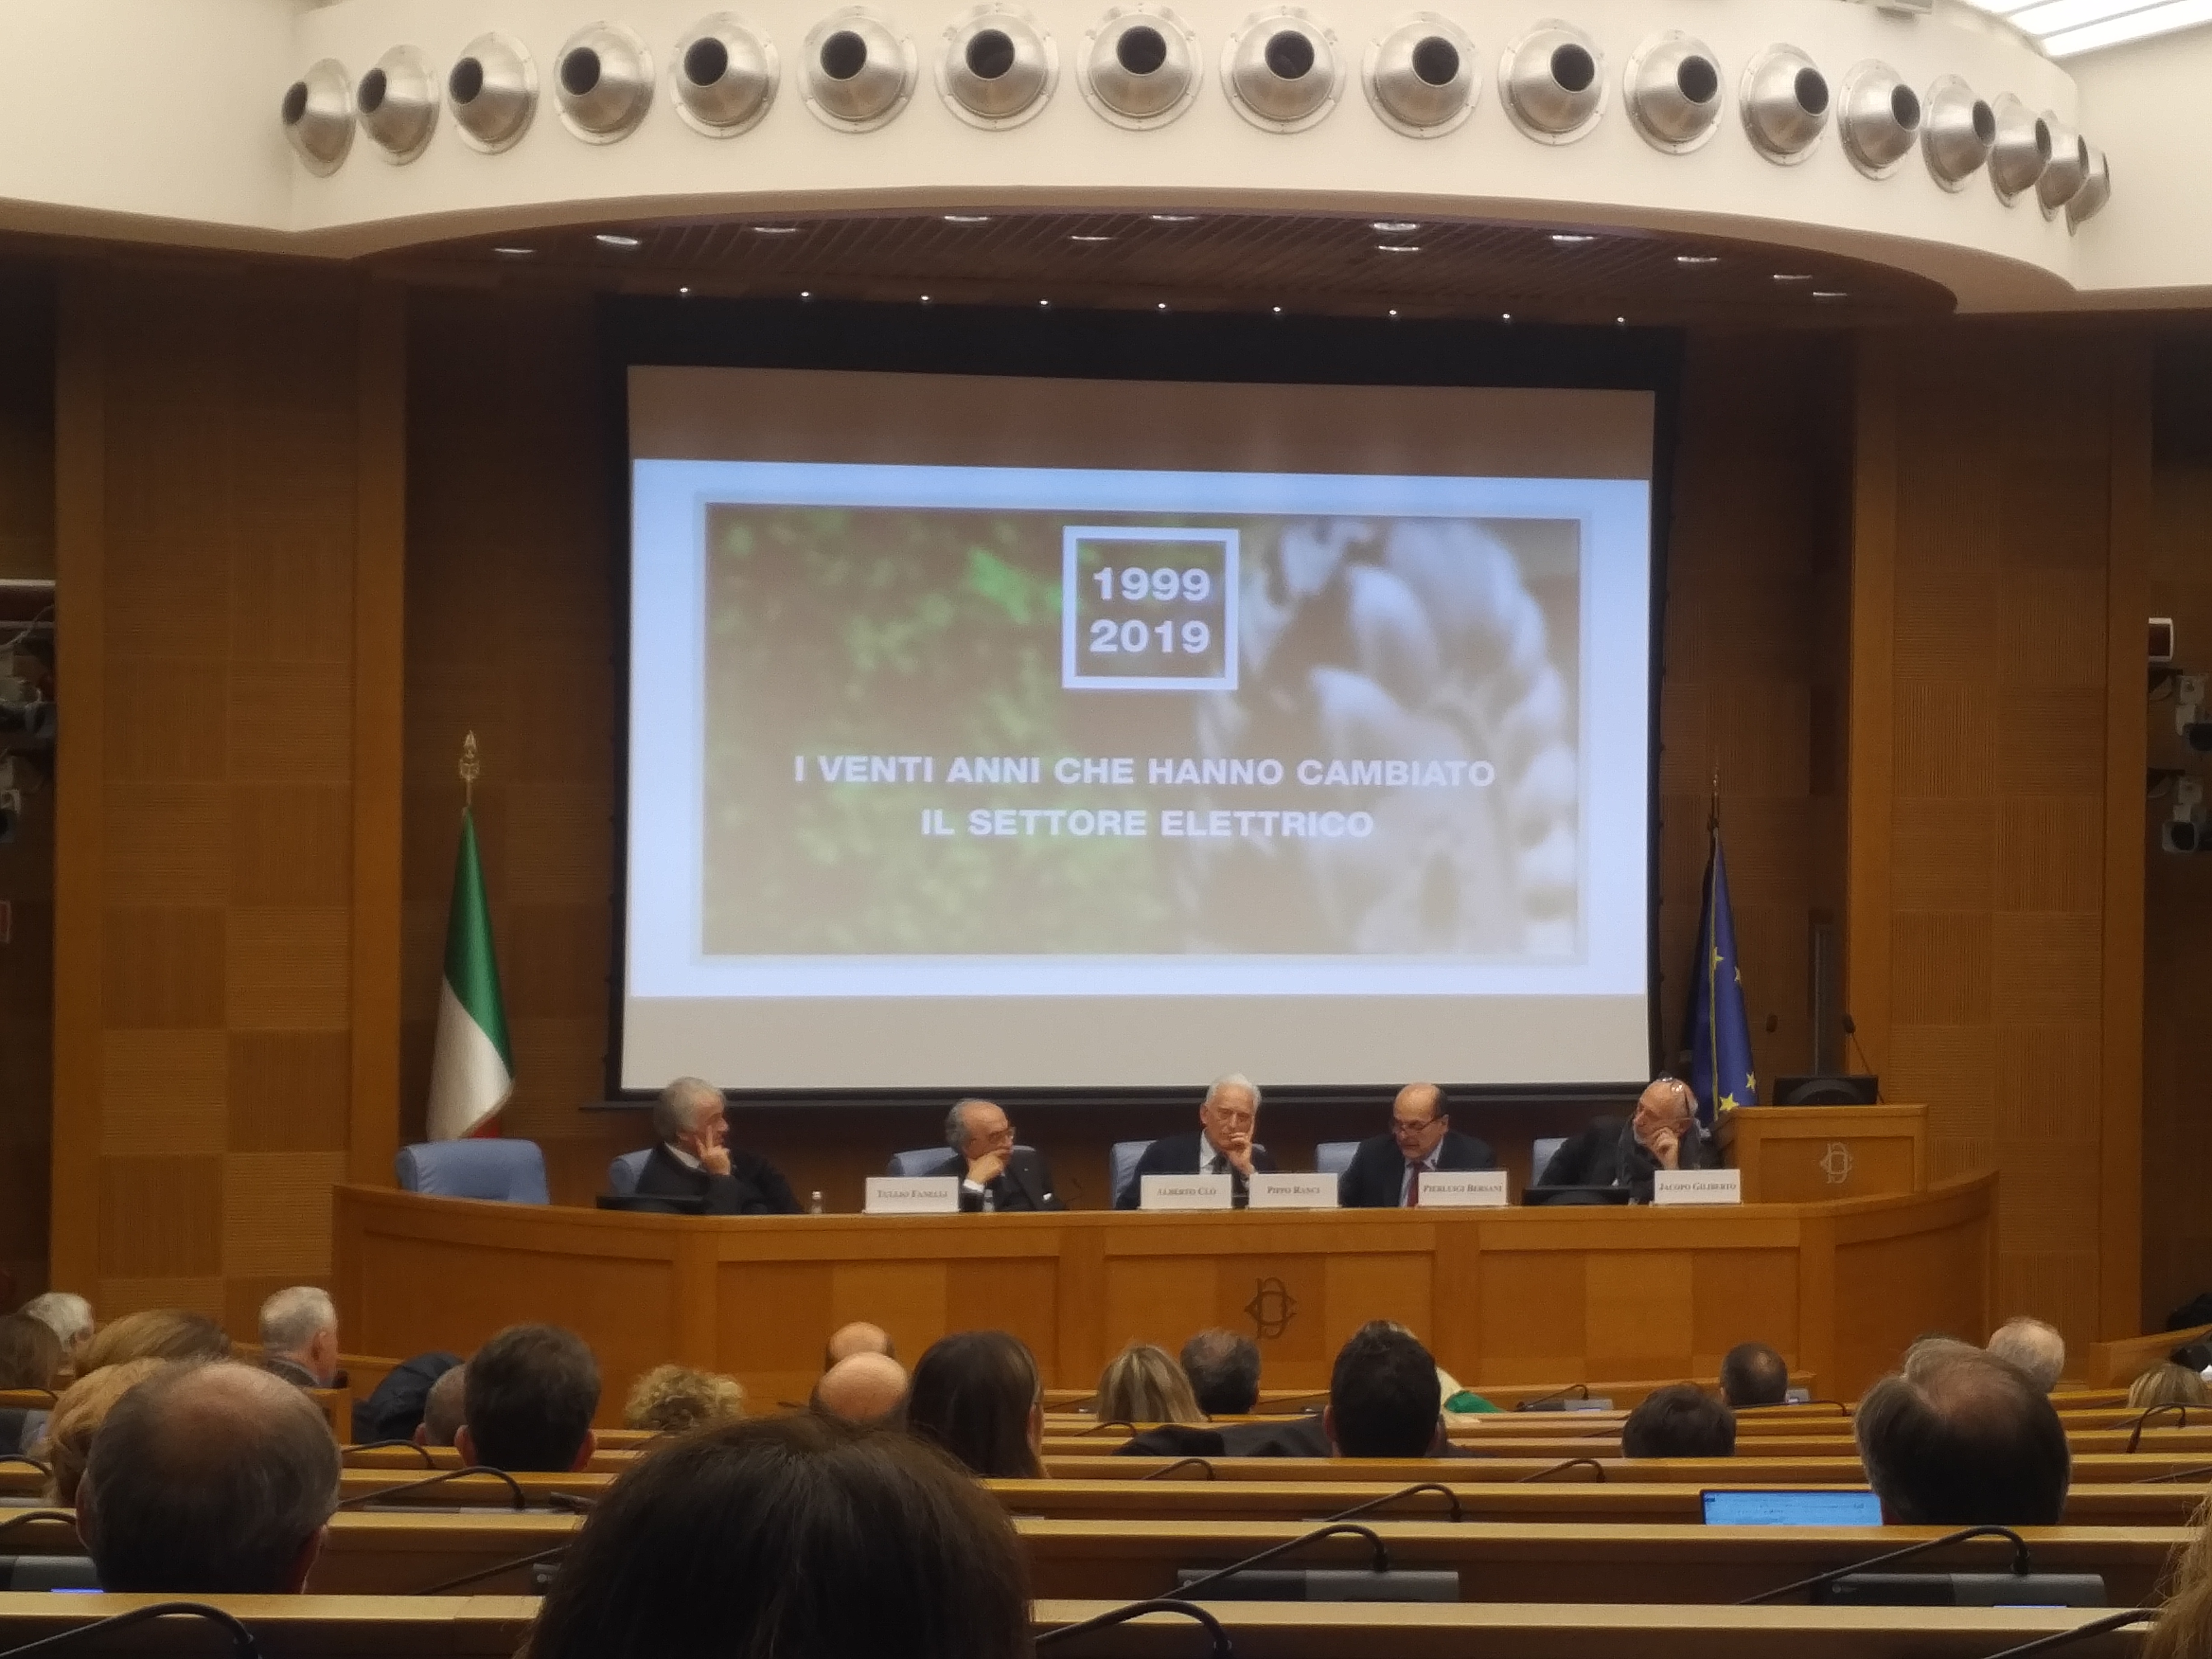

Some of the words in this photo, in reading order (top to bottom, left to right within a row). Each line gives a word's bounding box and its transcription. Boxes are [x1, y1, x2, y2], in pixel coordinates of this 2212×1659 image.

[1092, 567, 1211, 601] 1999
[1089, 619, 1211, 654] 2019
[794, 756, 805, 783] I
[817, 756, 934, 783] VENTI
[946, 757, 1041, 783] ANNI
[1054, 757, 1134, 784] CHE
[1148, 759, 1284, 786] HANNO
[1297, 759, 1496, 787] CAMBIATO
[921, 809, 955, 835] IL
[968, 809, 1147, 836] SETTORE
[1161, 810, 1374, 838] ELETTRICO
